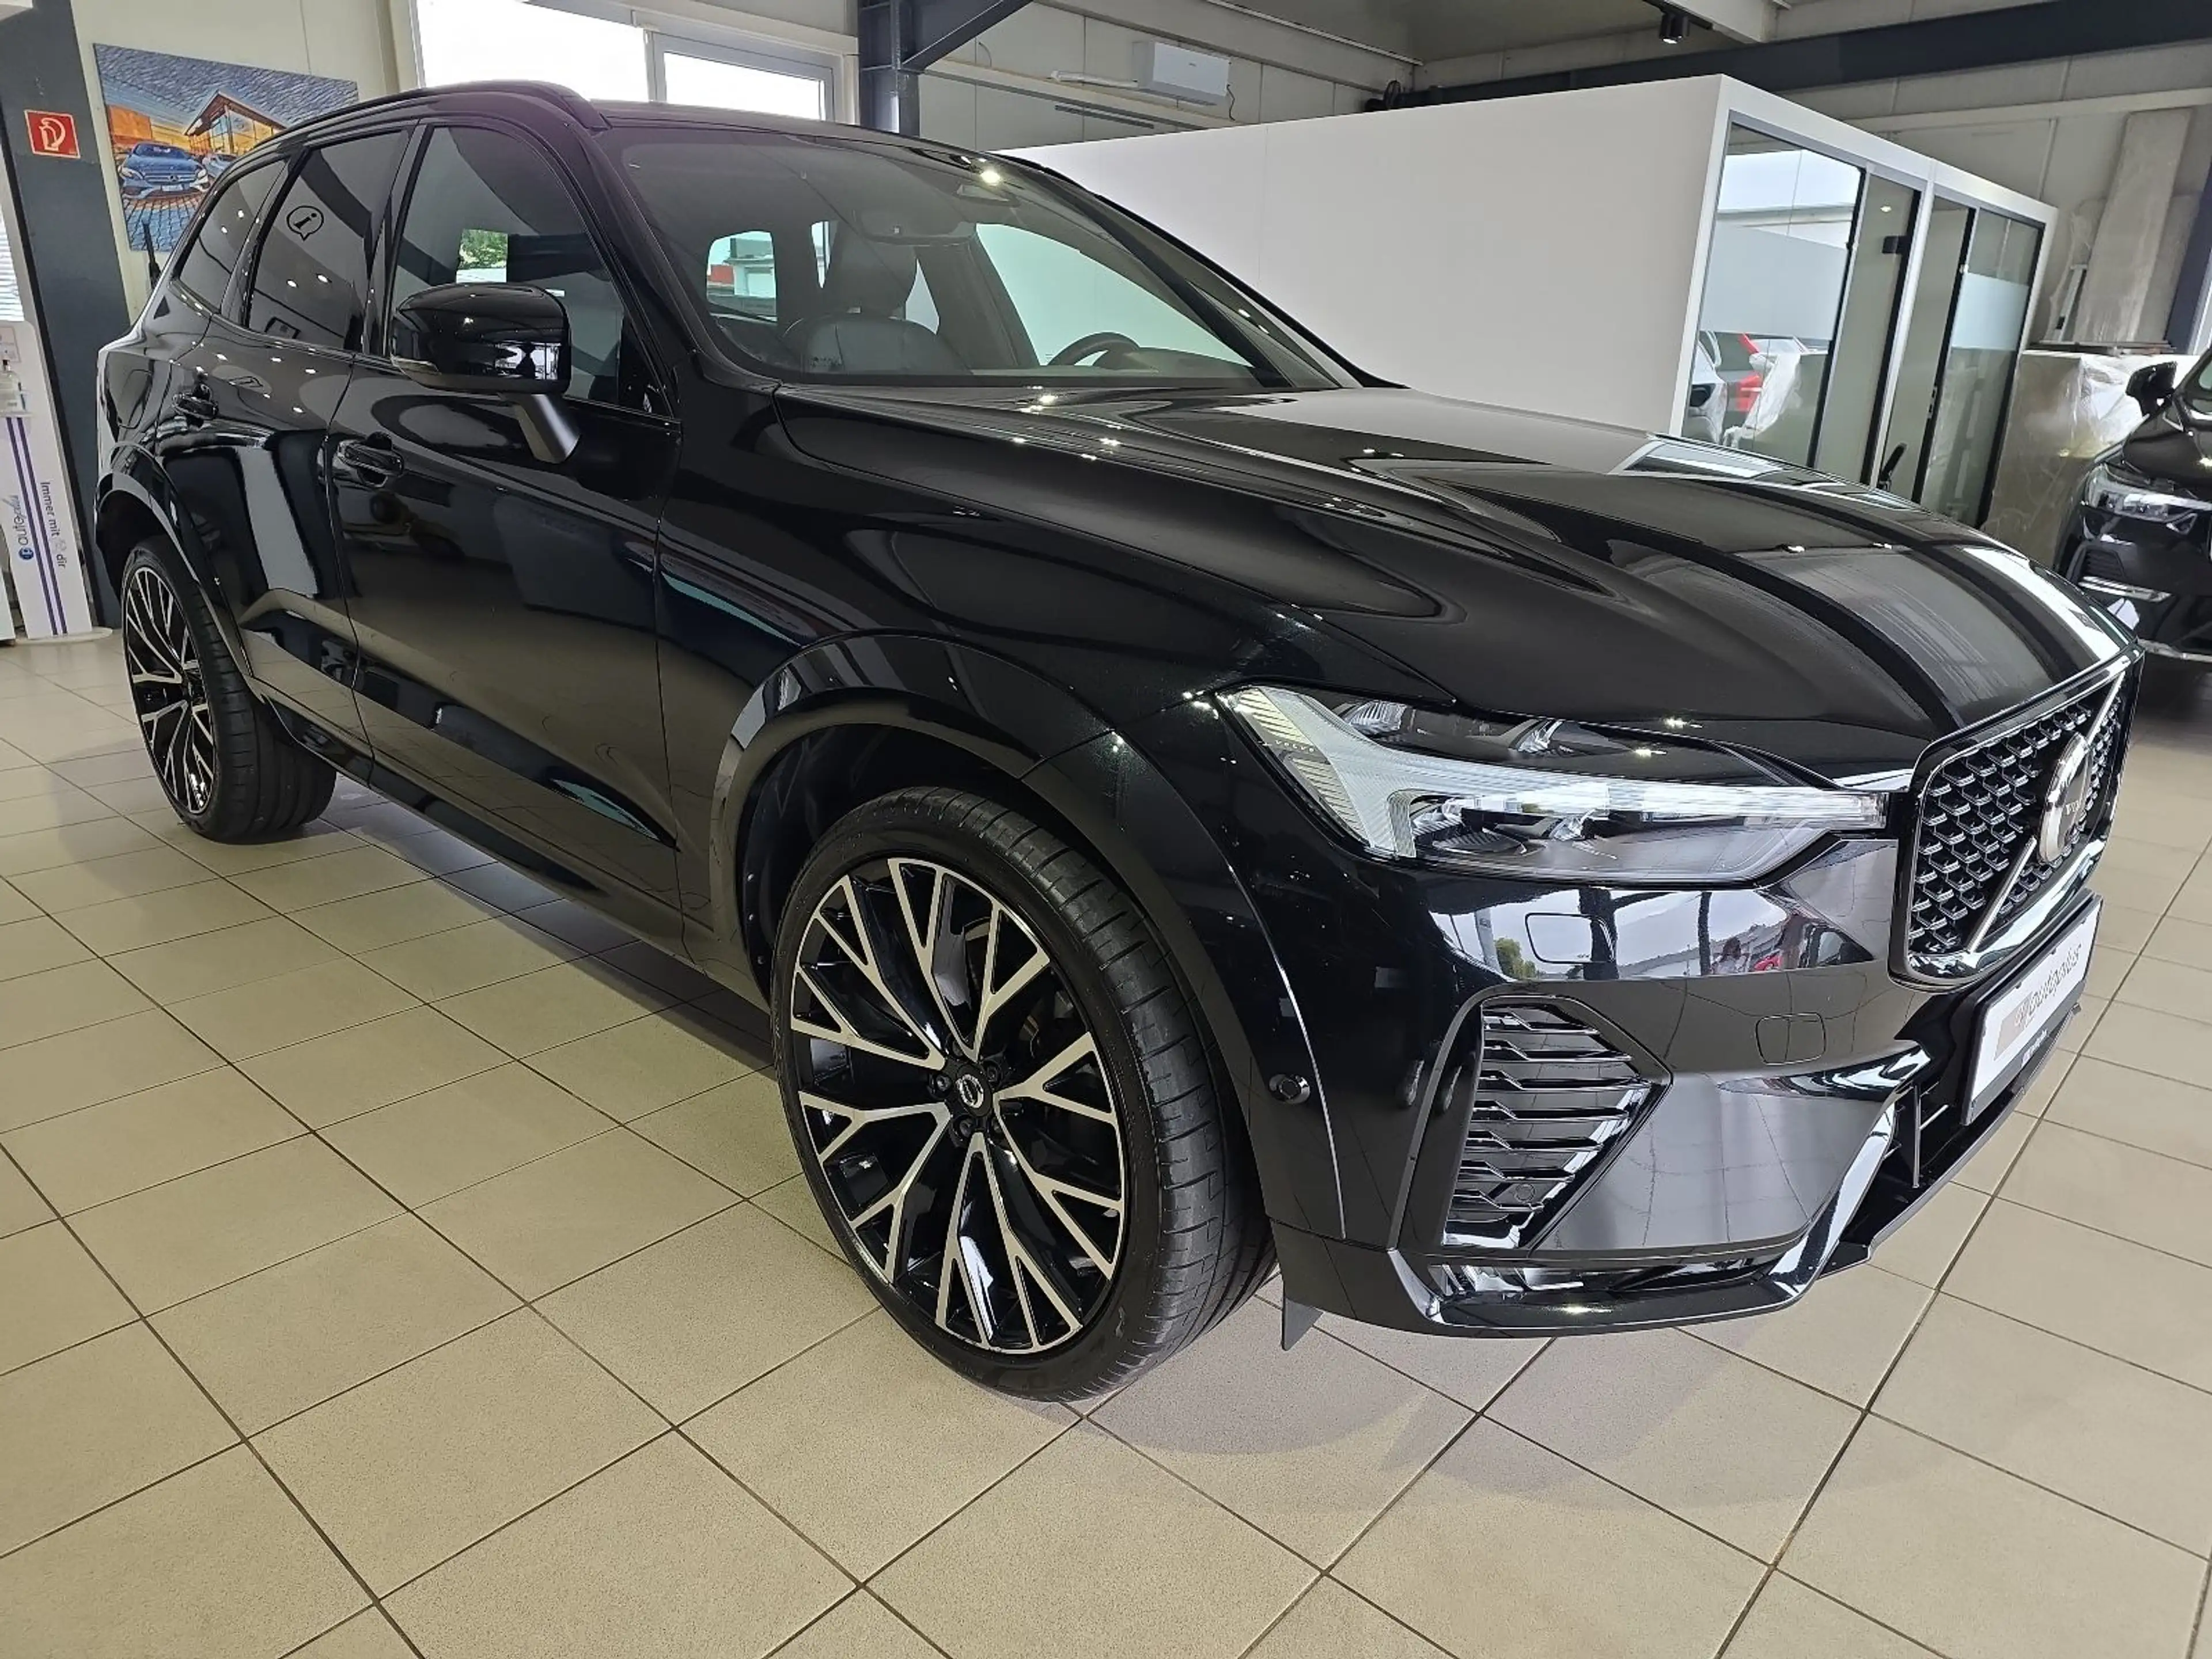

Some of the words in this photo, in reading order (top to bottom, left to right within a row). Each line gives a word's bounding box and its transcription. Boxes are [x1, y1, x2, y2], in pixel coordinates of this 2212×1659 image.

[40, 482, 54, 516] Immer
[48, 519, 60, 536] mit
[56, 554, 67, 568] dir
